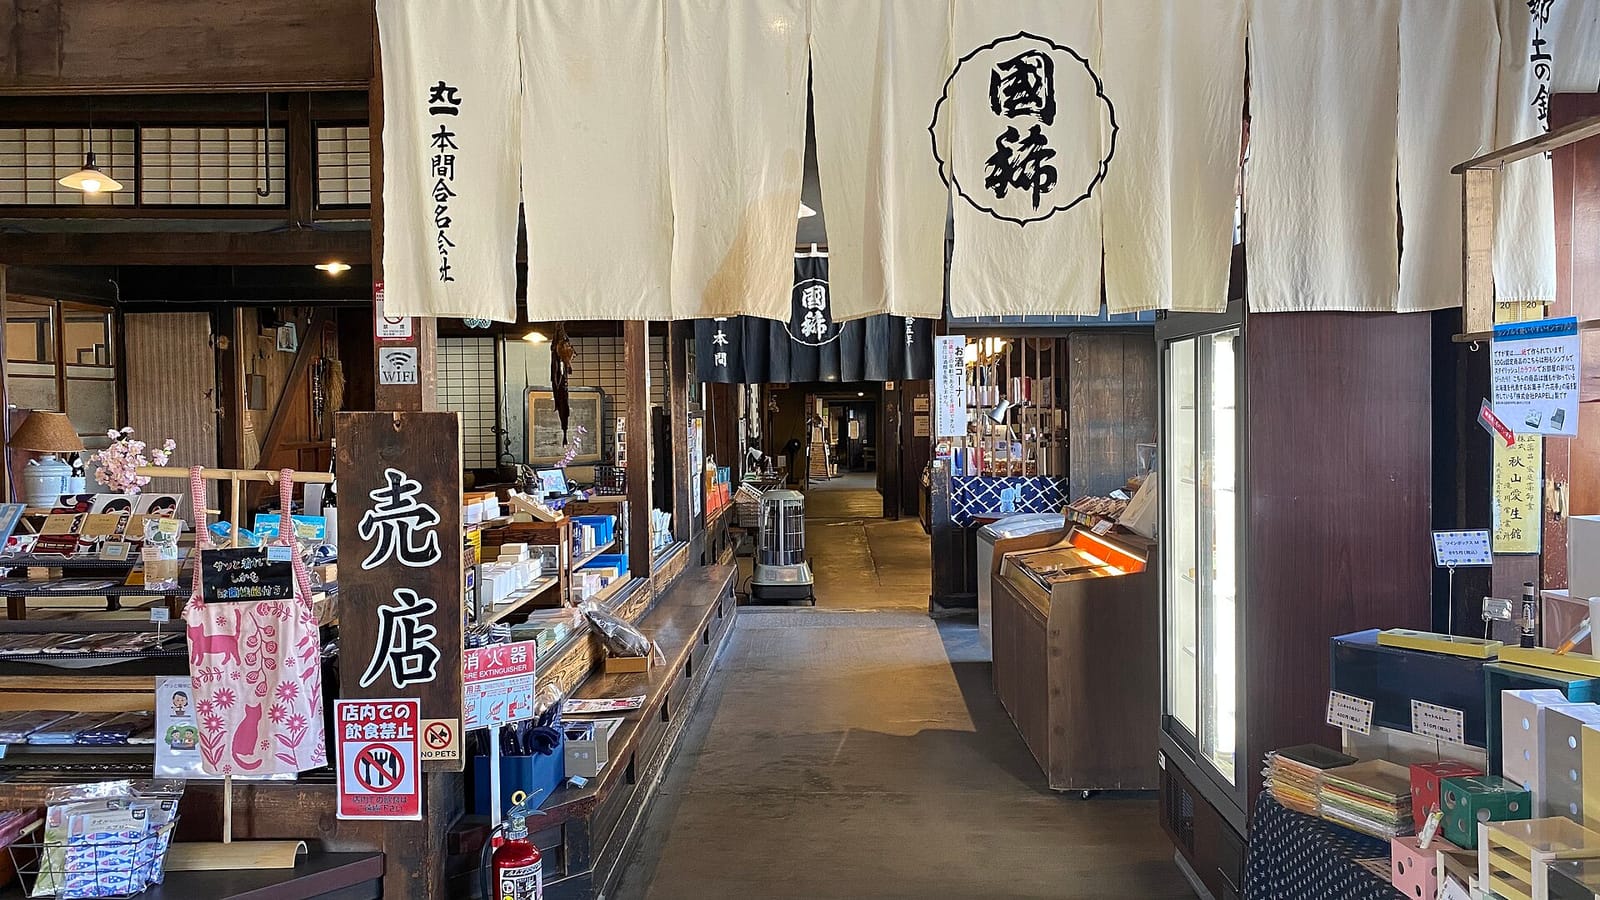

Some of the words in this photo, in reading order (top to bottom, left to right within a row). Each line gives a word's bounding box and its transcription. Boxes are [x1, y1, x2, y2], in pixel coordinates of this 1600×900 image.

[985, 49, 1058, 212] 國稀
[382, 371, 415, 383] WIFI
[954, 346, 964, 408] お酒コーナー
[357, 467, 443, 689] 売店
[463, 645, 528, 671] 消火器
[479, 663, 527, 679] EXTINGUISHER
[342, 703, 410, 721] 店内での
[344, 723, 415, 740] 飲食禁止
[421, 750, 433, 758] NO
[434, 750, 457, 758] PETS
